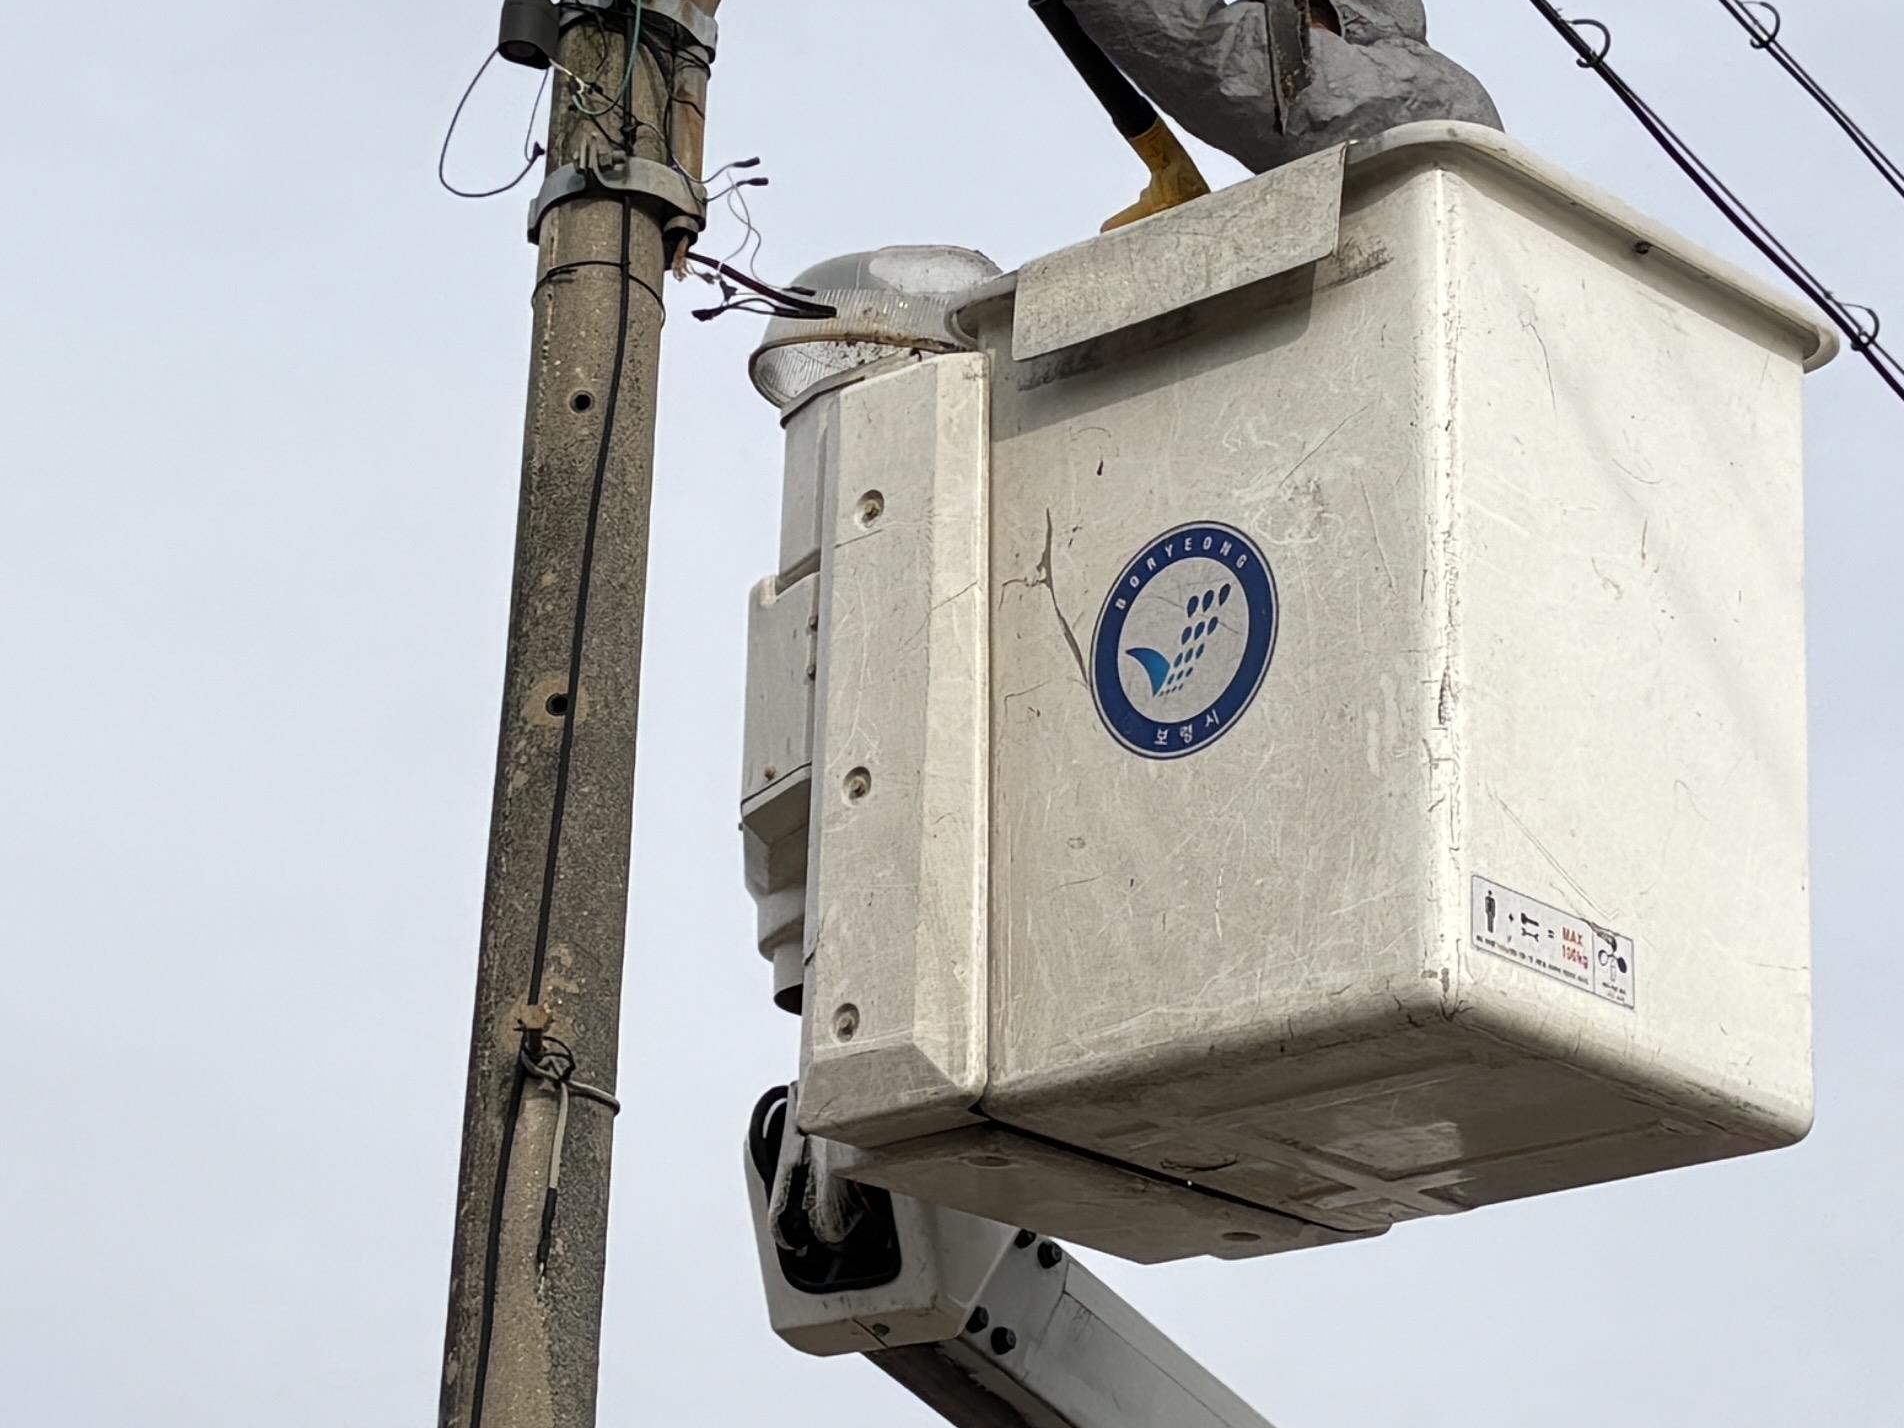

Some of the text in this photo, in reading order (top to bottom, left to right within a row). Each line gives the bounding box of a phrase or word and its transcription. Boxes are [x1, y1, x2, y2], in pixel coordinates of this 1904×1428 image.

[1115, 535, 1248, 610] BORYEONG
[1153, 708, 1220, 746] 보령시
[1562, 926, 1583, 946] MAX
